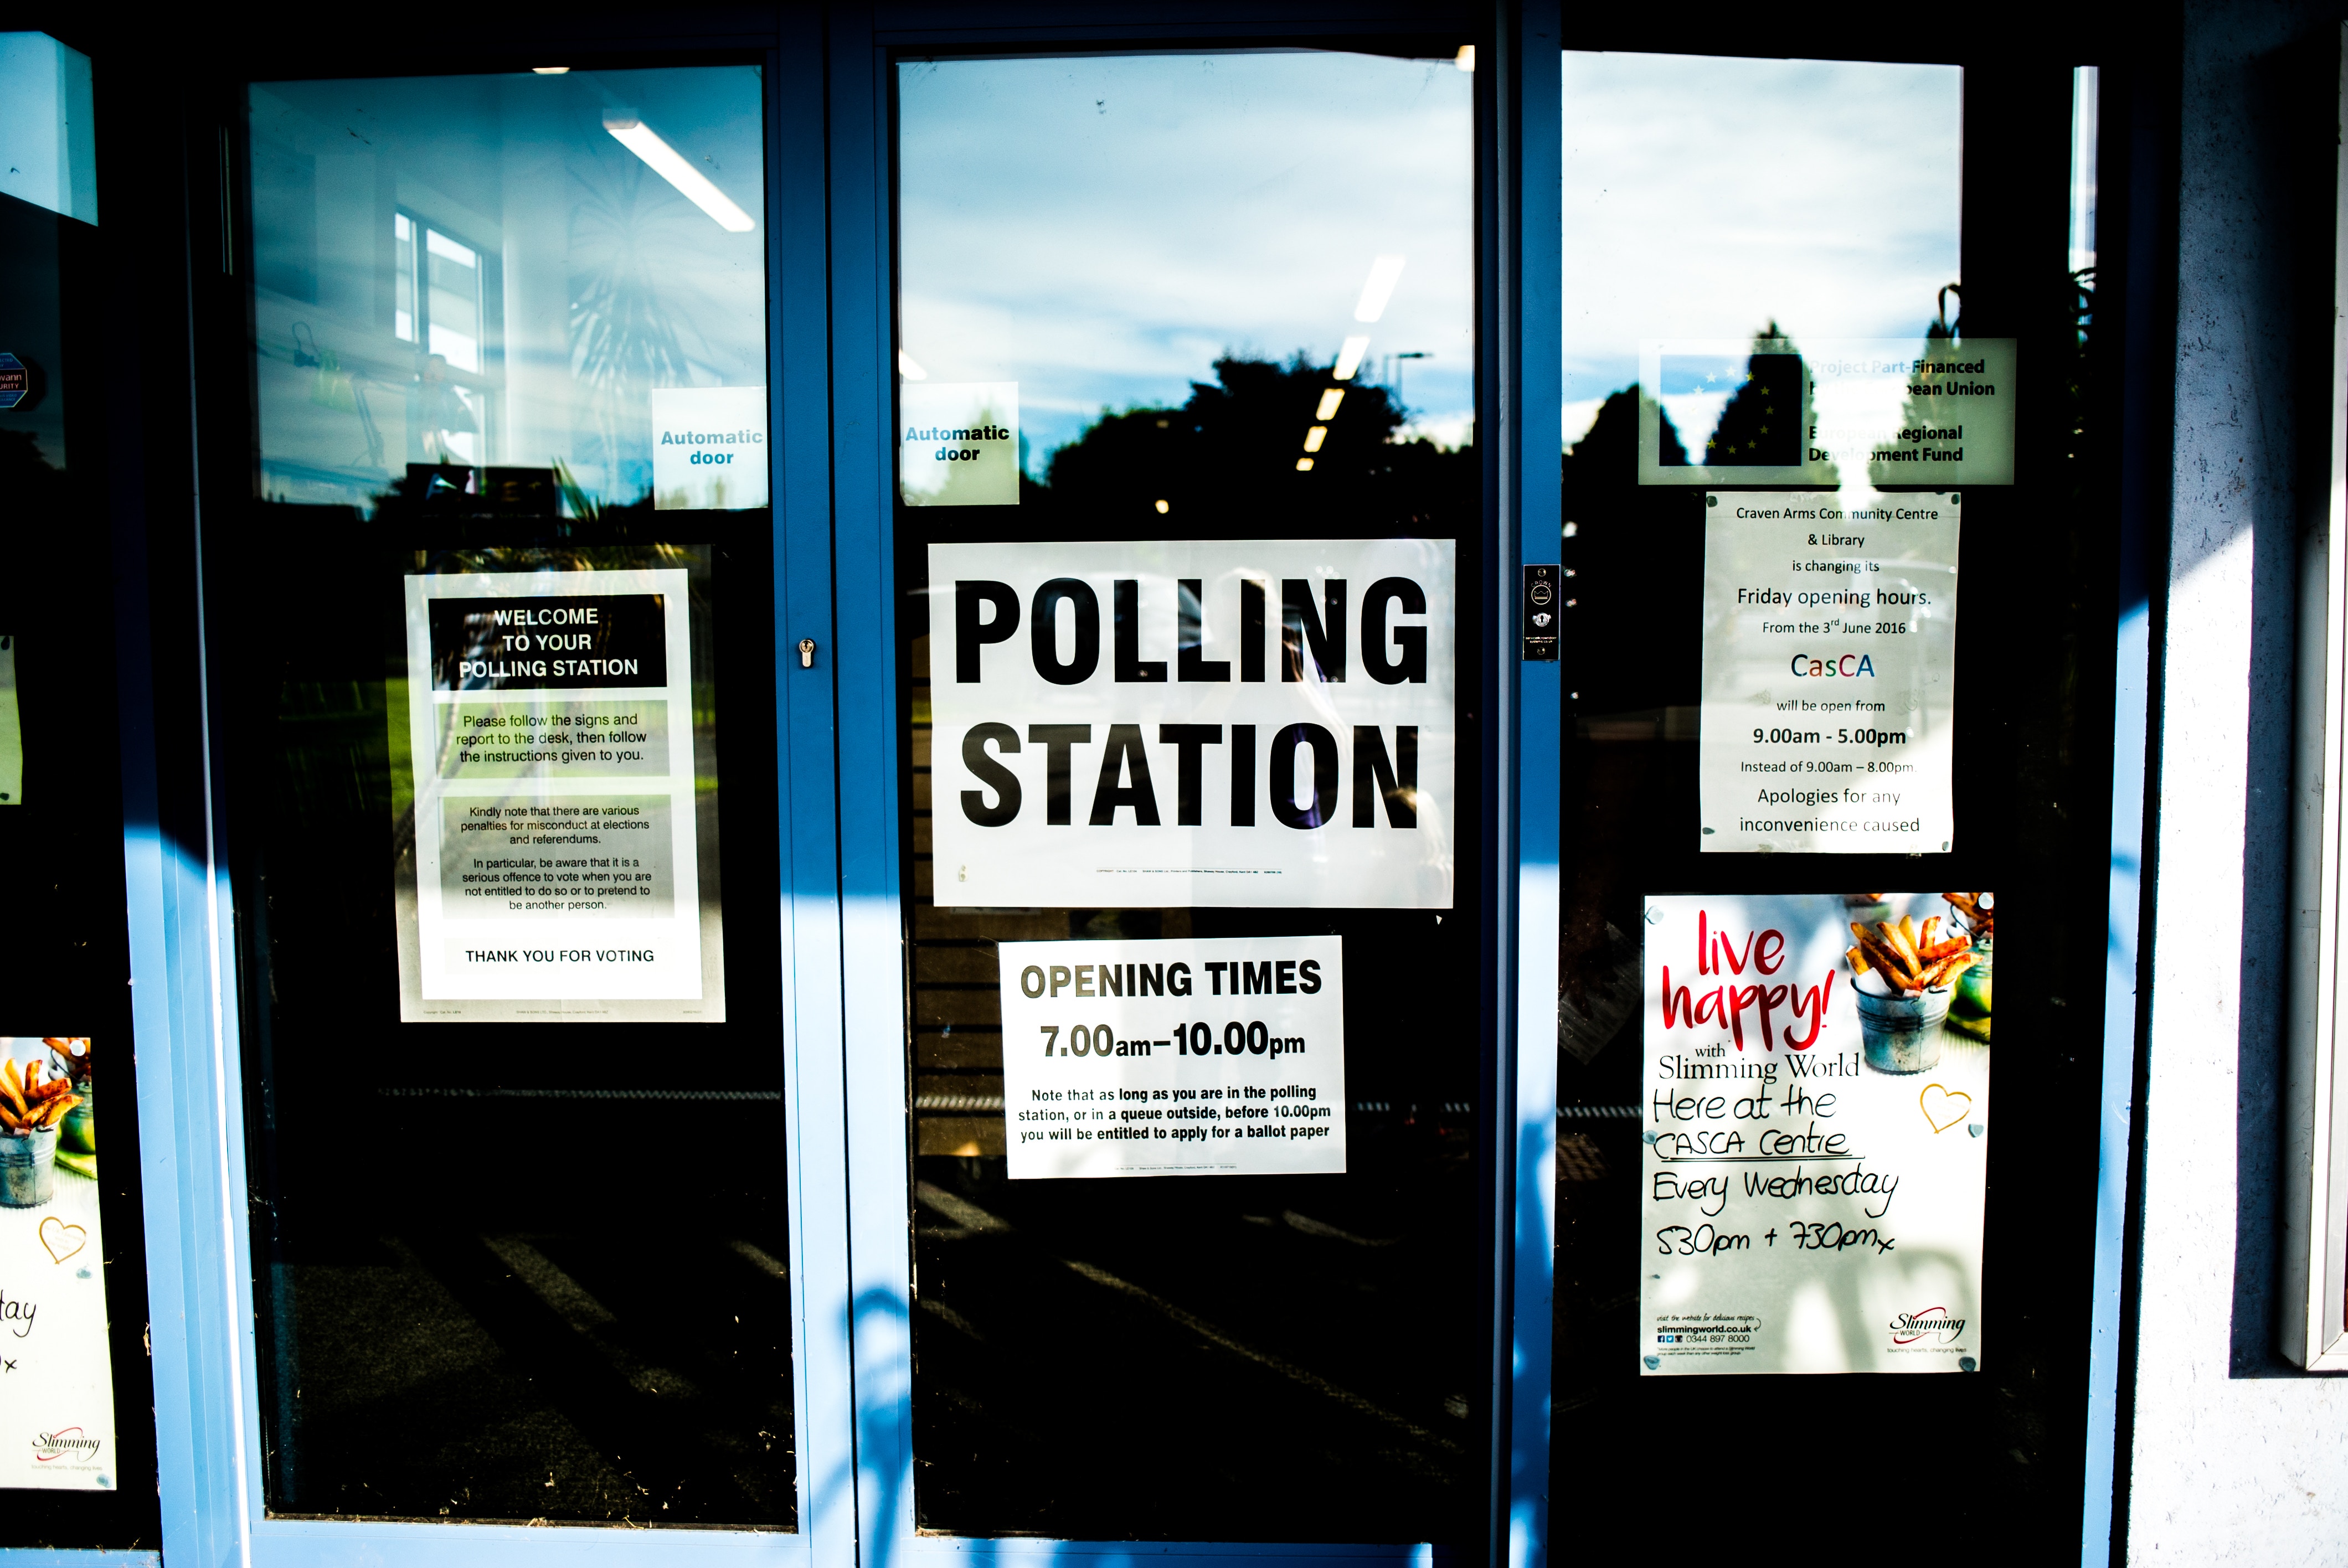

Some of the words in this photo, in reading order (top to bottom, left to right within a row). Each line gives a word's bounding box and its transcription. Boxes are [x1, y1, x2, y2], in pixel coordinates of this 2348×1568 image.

[1810, 359, 1867, 376] Project
[1872, 359, 1984, 373] Part-Financed
[1947, 382, 1994, 395] Union
[661, 430, 762, 445] Automatic
[906, 425, 1009, 440] Automatic
[691, 451, 733, 465] door
[935, 447, 980, 461] door
[1922, 447, 1963, 461] Fund
[1737, 508, 1779, 518] Craven
[1784, 508, 1815, 519] Arms
[1820, 508, 1892, 522] Community
[1896, 508, 1938, 519] Centre
[1808, 534, 1817, 545] &
[1822, 534, 1865, 548] Library
[1793, 560, 1801, 571] is
[1805, 560, 1861, 574] changing
[1866, 561, 1879, 571] its
[1738, 588, 1792, 607] Friday
[1798, 589, 1870, 608] opening
[1877, 589, 1930, 605] hours.
[495, 608, 598, 626] WELCOME
[956, 577, 1427, 685] POLLING
[1763, 622, 1794, 633] From
[1799, 622, 1819, 633] the
[1842, 623, 1871, 633] June
[1876, 623, 1906, 633] 2016
[503, 635, 529, 651] TO
[537, 634, 591, 651] YOUR
[460, 661, 547, 678] POLLING
[553, 659, 637, 675] STATION
[1791, 654, 1875, 677] CasCA
[1777, 700, 1797, 710] will
[1803, 700, 1816, 711] be
[1821, 703, 1851, 713] open
[1856, 700, 1884, 711] from
[464, 716, 506, 727] Please
[510, 715, 547, 726] follow
[552, 715, 571, 726] the
[575, 714, 609, 728] signs
[614, 713, 637, 725] and
[457, 734, 494, 747] report
[498, 734, 510, 744] to
[514, 733, 534, 744] the
[539, 731, 572, 745] desk,
[576, 731, 605, 743] then
[609, 731, 646, 742] follow
[1754, 729, 1820, 743] 9.00am
[1839, 729, 1906, 747] 5.00pm
[460, 751, 480, 762] the
[485, 750, 557, 762] instructions
[562, 749, 595, 764] given
[600, 750, 612, 760] to
[616, 751, 643, 763] you.
[1742, 761, 1785, 772] Instead
[1790, 761, 1803, 772] of
[1806, 762, 1852, 772] 9.00am
[960, 723, 1418, 829] STATION
[1758, 788, 1838, 806] Apologies
[1844, 788, 1865, 802] for
[1873, 793, 1900, 806] any
[470, 807, 501, 819] Kindly
[505, 807, 527, 816] note
[531, 807, 550, 816] that
[553, 806, 579, 816] there
[602, 806, 639, 815] various
[461, 821, 507, 833] penalties
[510, 821, 524, 830] for
[527, 820, 588, 830] misconduct
[591, 821, 600, 829] at
[603, 820, 649, 829] elections
[1741, 817, 1857, 831] inconvenience
[1864, 818, 1919, 831] caused
[510, 834, 529, 844] and
[533, 834, 600, 844] referendums.
[1699, 910, 1785, 976] live
[466, 951, 518, 962] THANK
[523, 951, 554, 962] YOU
[560, 950, 590, 962] FOR
[596, 950, 653, 962] VOTING
[1021, 962, 1192, 999] OPENING
[1204, 960, 1322, 996] TIMES
[1663, 966, 1835, 1051] happy!
[1695, 1043, 1725, 1057] with
[1659, 1054, 1778, 1084] Slimming
[1785, 1052, 1858, 1078] World
[1032, 1090, 1062, 1101] Note
[1068, 1090, 1094, 1100] that
[1100, 1092, 1114, 1100] as
[1120, 1089, 1147, 1103] long
[1153, 1090, 1168, 1100] as
[1172, 1090, 1196, 1102] you
[1201, 1090, 1223, 1099] are
[1228, 1086, 1239, 1098] in
[1244, 1086, 1266, 1098] the
[1271, 1085, 1316, 1101] polling
[1654, 1088, 1725, 1122] Here
[1734, 1084, 1772, 1120] at
[1780, 1084, 1836, 1117] the
[1019, 1109, 1068, 1122] station,
[1074, 1112, 1087, 1120] or
[1092, 1108, 1103, 1120] in
[1109, 1111, 1116, 1120] a
[1121, 1110, 1162, 1123] queue
[1167, 1106, 1221, 1121] outside,
[1226, 1106, 1268, 1118] before
[1274, 1105, 1330, 1120] 10.00pm
[1021, 1132, 1043, 1143] you
[1049, 1128, 1071, 1139] will
[1077, 1128, 1092, 1139] be
[1098, 1127, 1149, 1139] entitled
[1154, 1127, 1166, 1139] to
[1171, 1126, 1207, 1142] apply
[1212, 1126, 1230, 1138] for
[1235, 1128, 1242, 1138] a
[1248, 1125, 1286, 1137] ballot
[1291, 1127, 1329, 1140] paper
[1654, 1131, 1745, 1159] CASCA
[1760, 1121, 1850, 1156] Centre
[1654, 1171, 1728, 1216] Every
[1744, 1163, 1898, 1218] Wednesday
[1657, 1325, 1751, 1334] slimmingworld.co.uk
[1890, 1313, 1965, 1340] Slimming
[33, 1432, 100, 1458] Slimming
